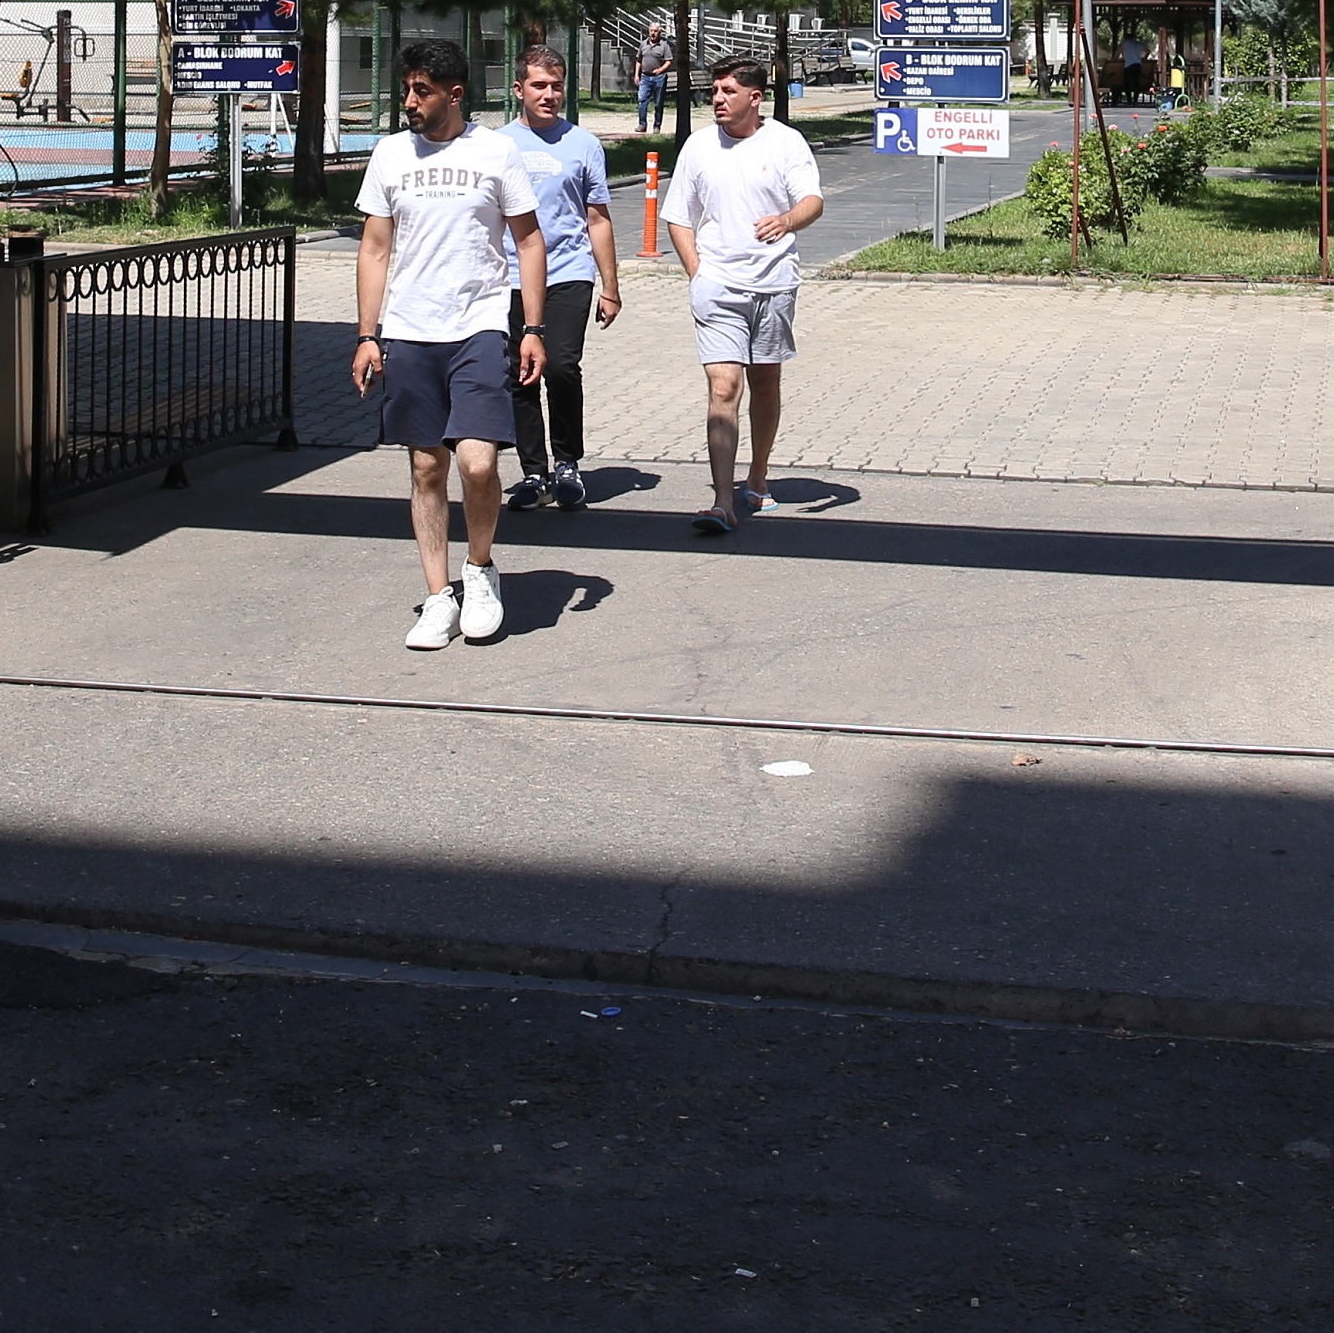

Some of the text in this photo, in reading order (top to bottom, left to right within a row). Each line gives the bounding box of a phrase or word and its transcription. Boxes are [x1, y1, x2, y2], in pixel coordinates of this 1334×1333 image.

[908, 7, 923, 15] YURT
[177, 48, 185, 58] A
[194, 47, 219, 58] BLOK
[220, 47, 263, 58] BODRUM
[264, 47, 283, 58] KAT
[905, 54, 913, 64] B
[920, 54, 943, 65] BLOK
[944, 54, 982, 66] BODRUM
[984, 55, 1001, 66] KAT
[906, 67, 927, 75] KAZAN
[906, 77, 924, 85] DEPO
[906, 86, 932, 95] MESCİD
[934, 109, 992, 124] ENGELLİ
[876, 112, 901, 149] P
[926, 127, 1000, 140] OTO PARKI
[401, 167, 483, 191] FREDDY
[425, 190, 456, 199] TRAINING
